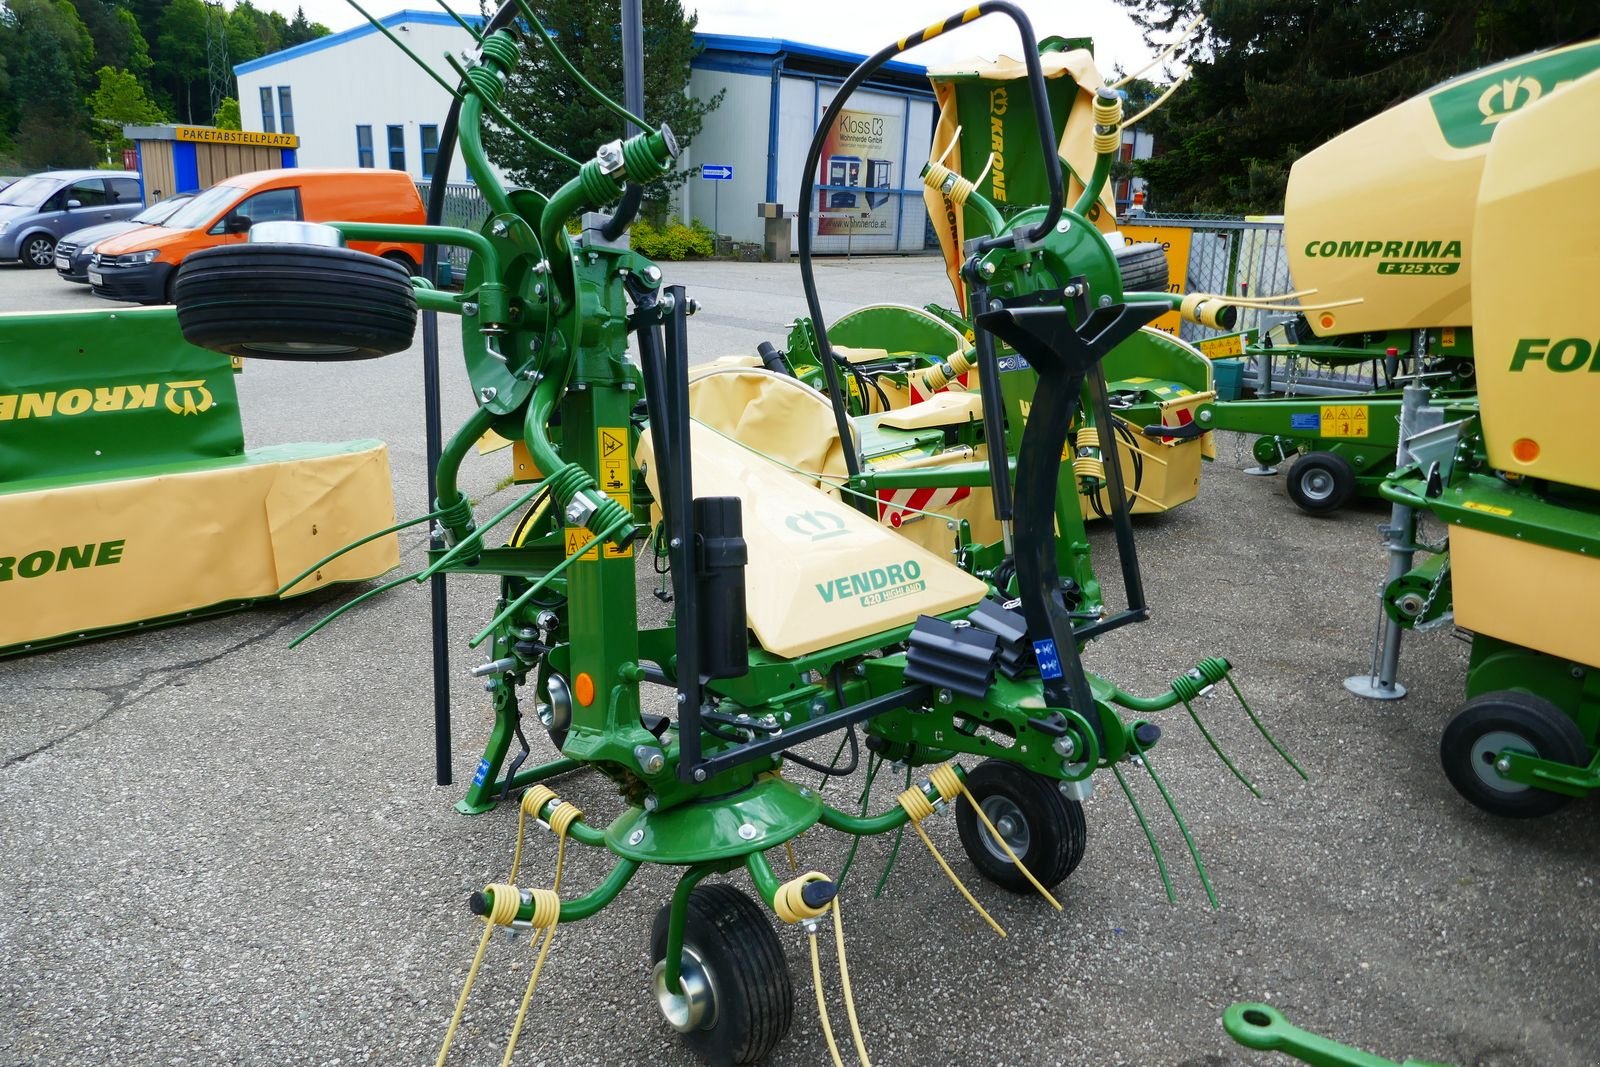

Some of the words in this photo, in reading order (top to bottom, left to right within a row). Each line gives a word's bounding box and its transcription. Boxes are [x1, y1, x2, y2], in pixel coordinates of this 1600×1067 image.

[840, 115, 870, 134] Kloss
[183, 130, 291, 145] PAKETABSTELLPLATZ
[840, 134, 867, 143] Wohnherde
[868, 136, 882, 144] GmbH
[991, 116, 1006, 202] KRONE
[1304, 240, 1462, 259] COMPRIMA
[1385, 264, 1397, 273] F
[1399, 264, 1423, 274] 125
[1426, 264, 1449, 274] XC
[815, 560, 921, 603] VENDRO
[863, 593, 881, 606] 420
[882, 582, 922, 601] HIGHLAND
